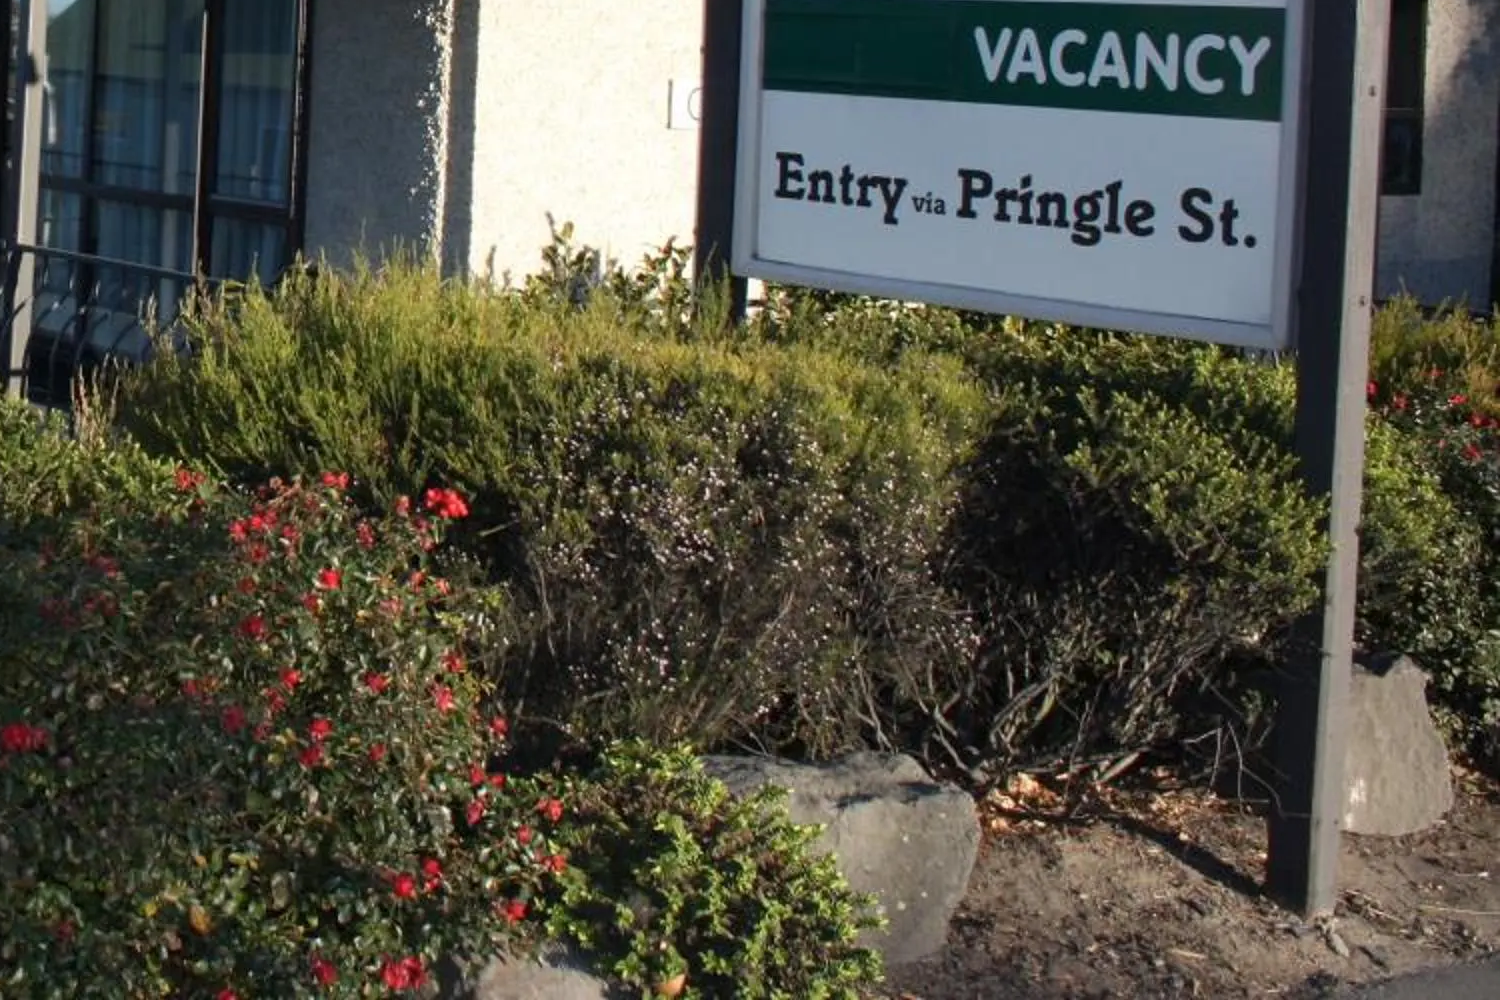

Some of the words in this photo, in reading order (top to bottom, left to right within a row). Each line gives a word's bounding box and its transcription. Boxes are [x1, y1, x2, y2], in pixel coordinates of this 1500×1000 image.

[975, 27, 1270, 95] VACANCY
[775, 152, 908, 225] Entry
[912, 192, 947, 216] via
[956, 168, 1156, 247] Pringle
[1178, 188, 1257, 248] St.
